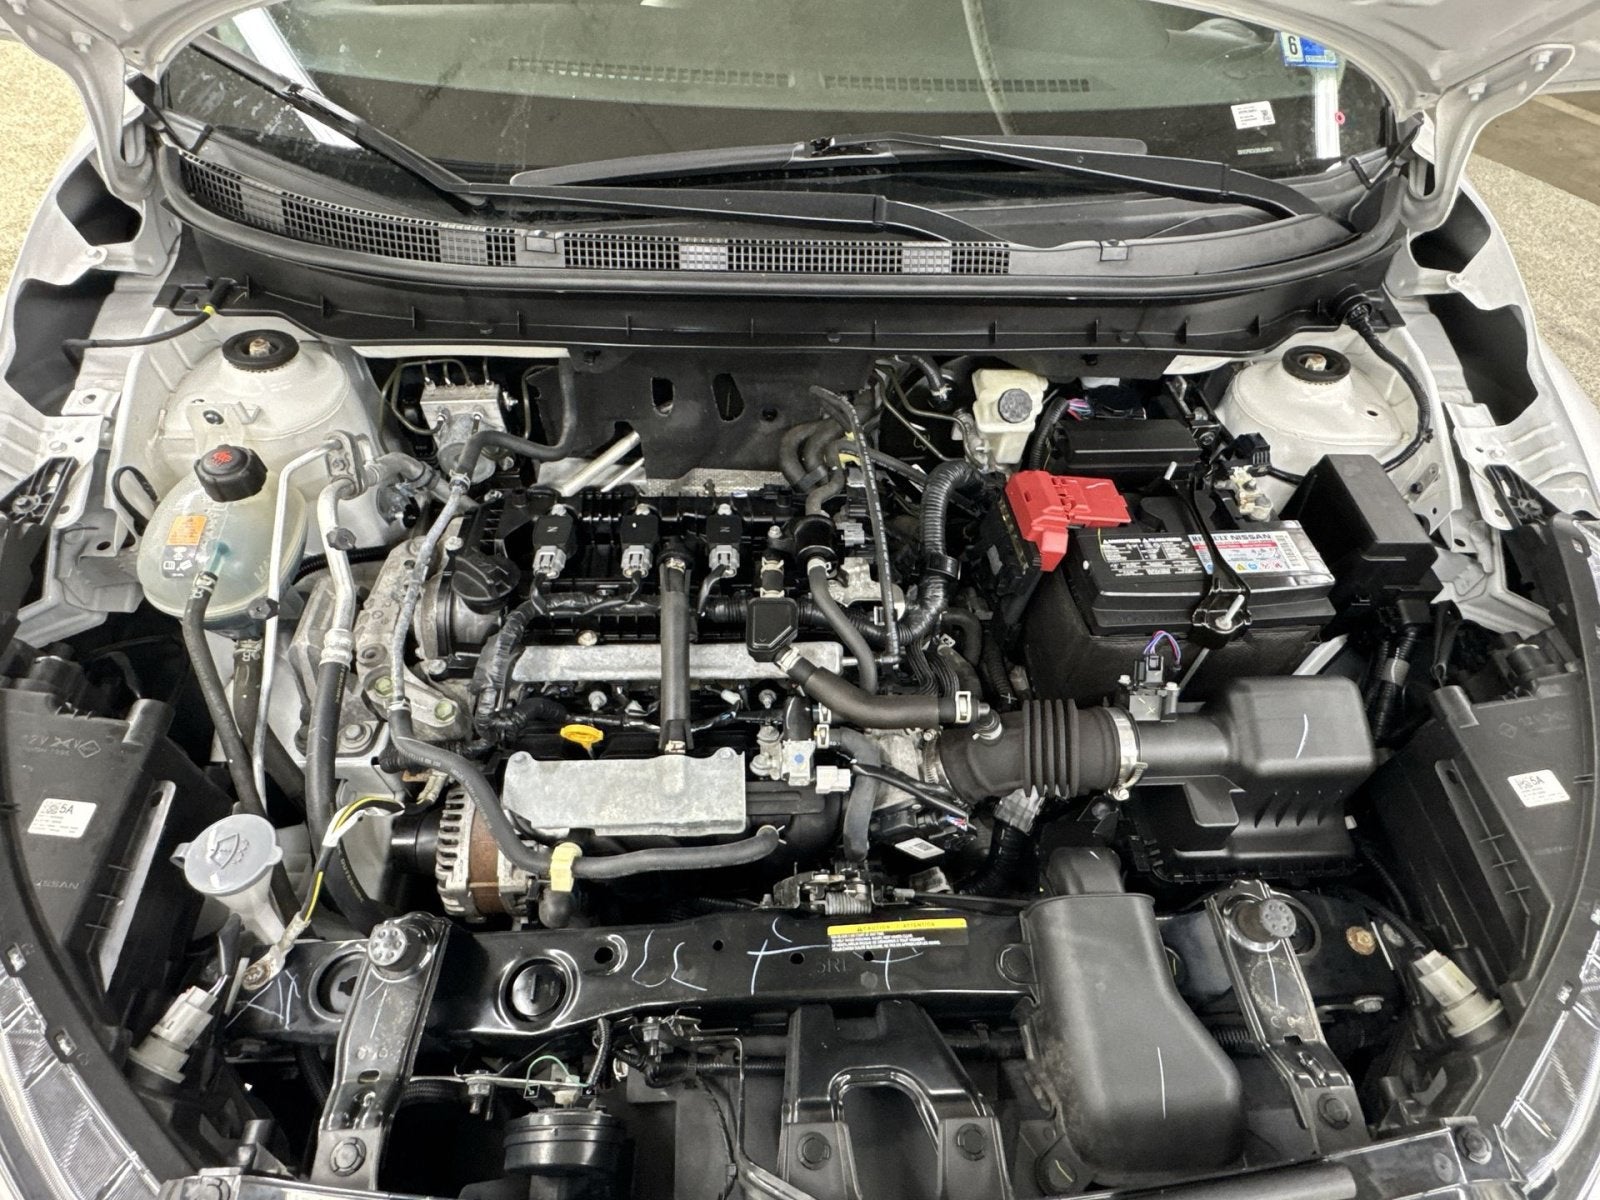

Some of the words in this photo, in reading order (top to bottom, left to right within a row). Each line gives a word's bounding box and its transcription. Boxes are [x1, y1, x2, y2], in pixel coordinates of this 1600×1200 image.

[1288, 36, 1298, 55] 6
[1231, 533, 1271, 541] NISSAN
[1529, 775, 1544, 785] 5A
[59, 803, 74, 815] 5A
